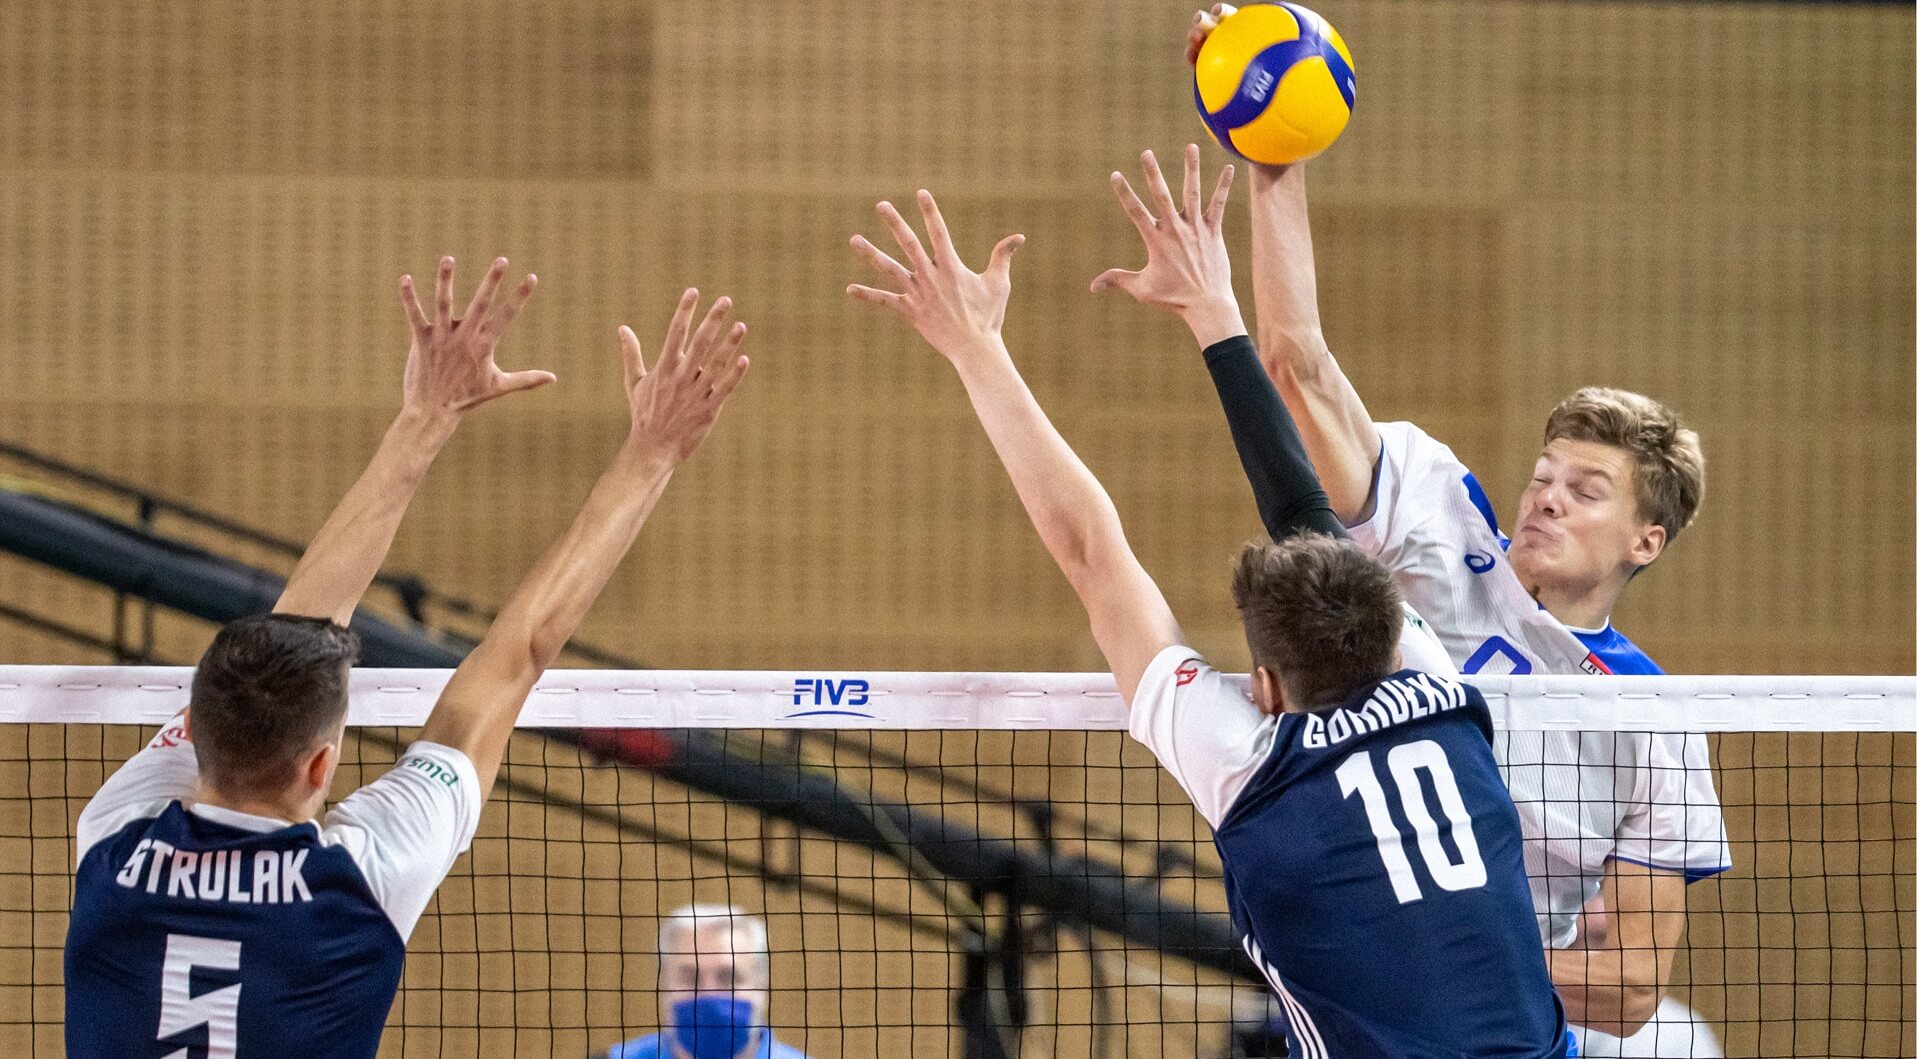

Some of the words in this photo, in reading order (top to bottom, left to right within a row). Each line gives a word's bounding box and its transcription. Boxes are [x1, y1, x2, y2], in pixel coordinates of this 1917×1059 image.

[794, 679, 869, 705] FIVB
[408, 758, 458, 787] plus
[1335, 740, 1488, 904] 10
[116, 838, 313, 904] STRULAK
[156, 933, 242, 1059] 5
